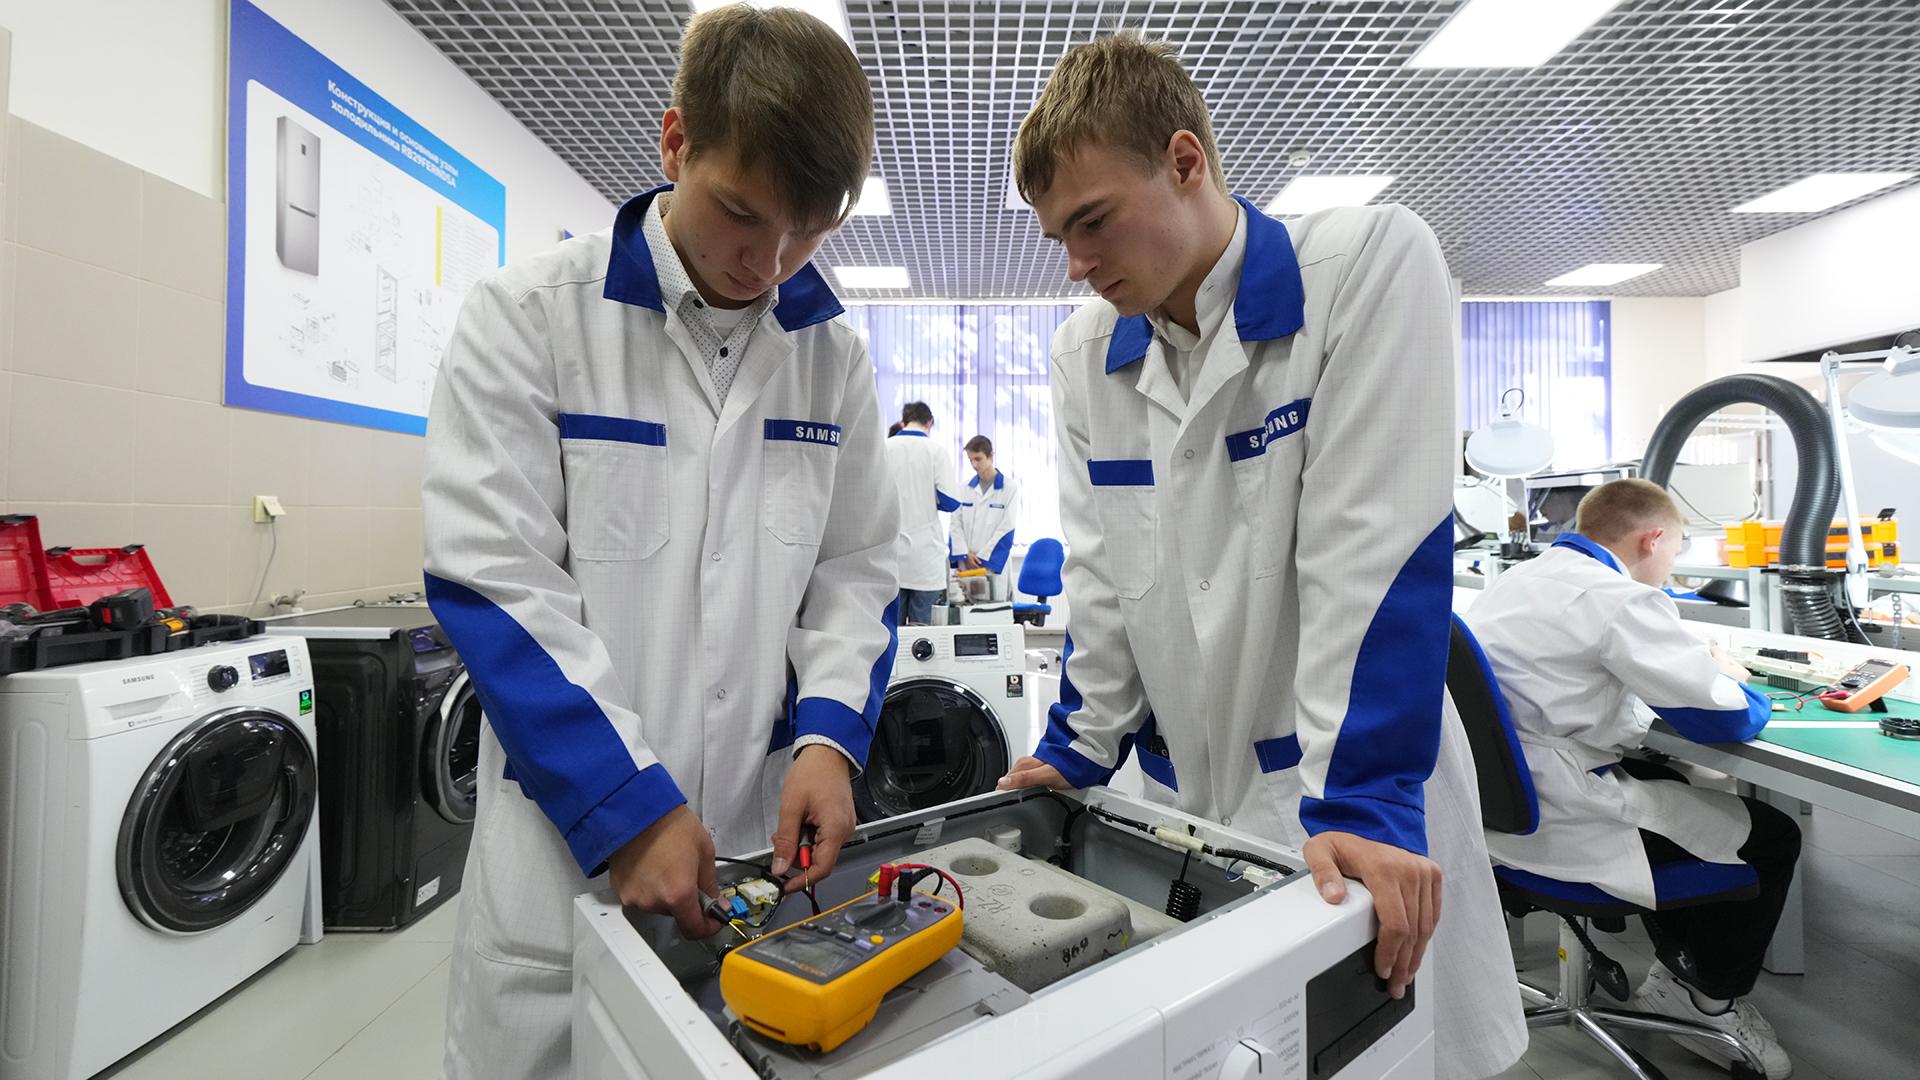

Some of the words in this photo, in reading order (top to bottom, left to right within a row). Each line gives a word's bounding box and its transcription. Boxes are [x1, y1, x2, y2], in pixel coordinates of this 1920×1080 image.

[328, 79, 391, 132] Конструкция
[391, 125, 399, 138] и
[331, 99, 400, 152] холодильника
[1249, 410, 1299, 449] SUNG
